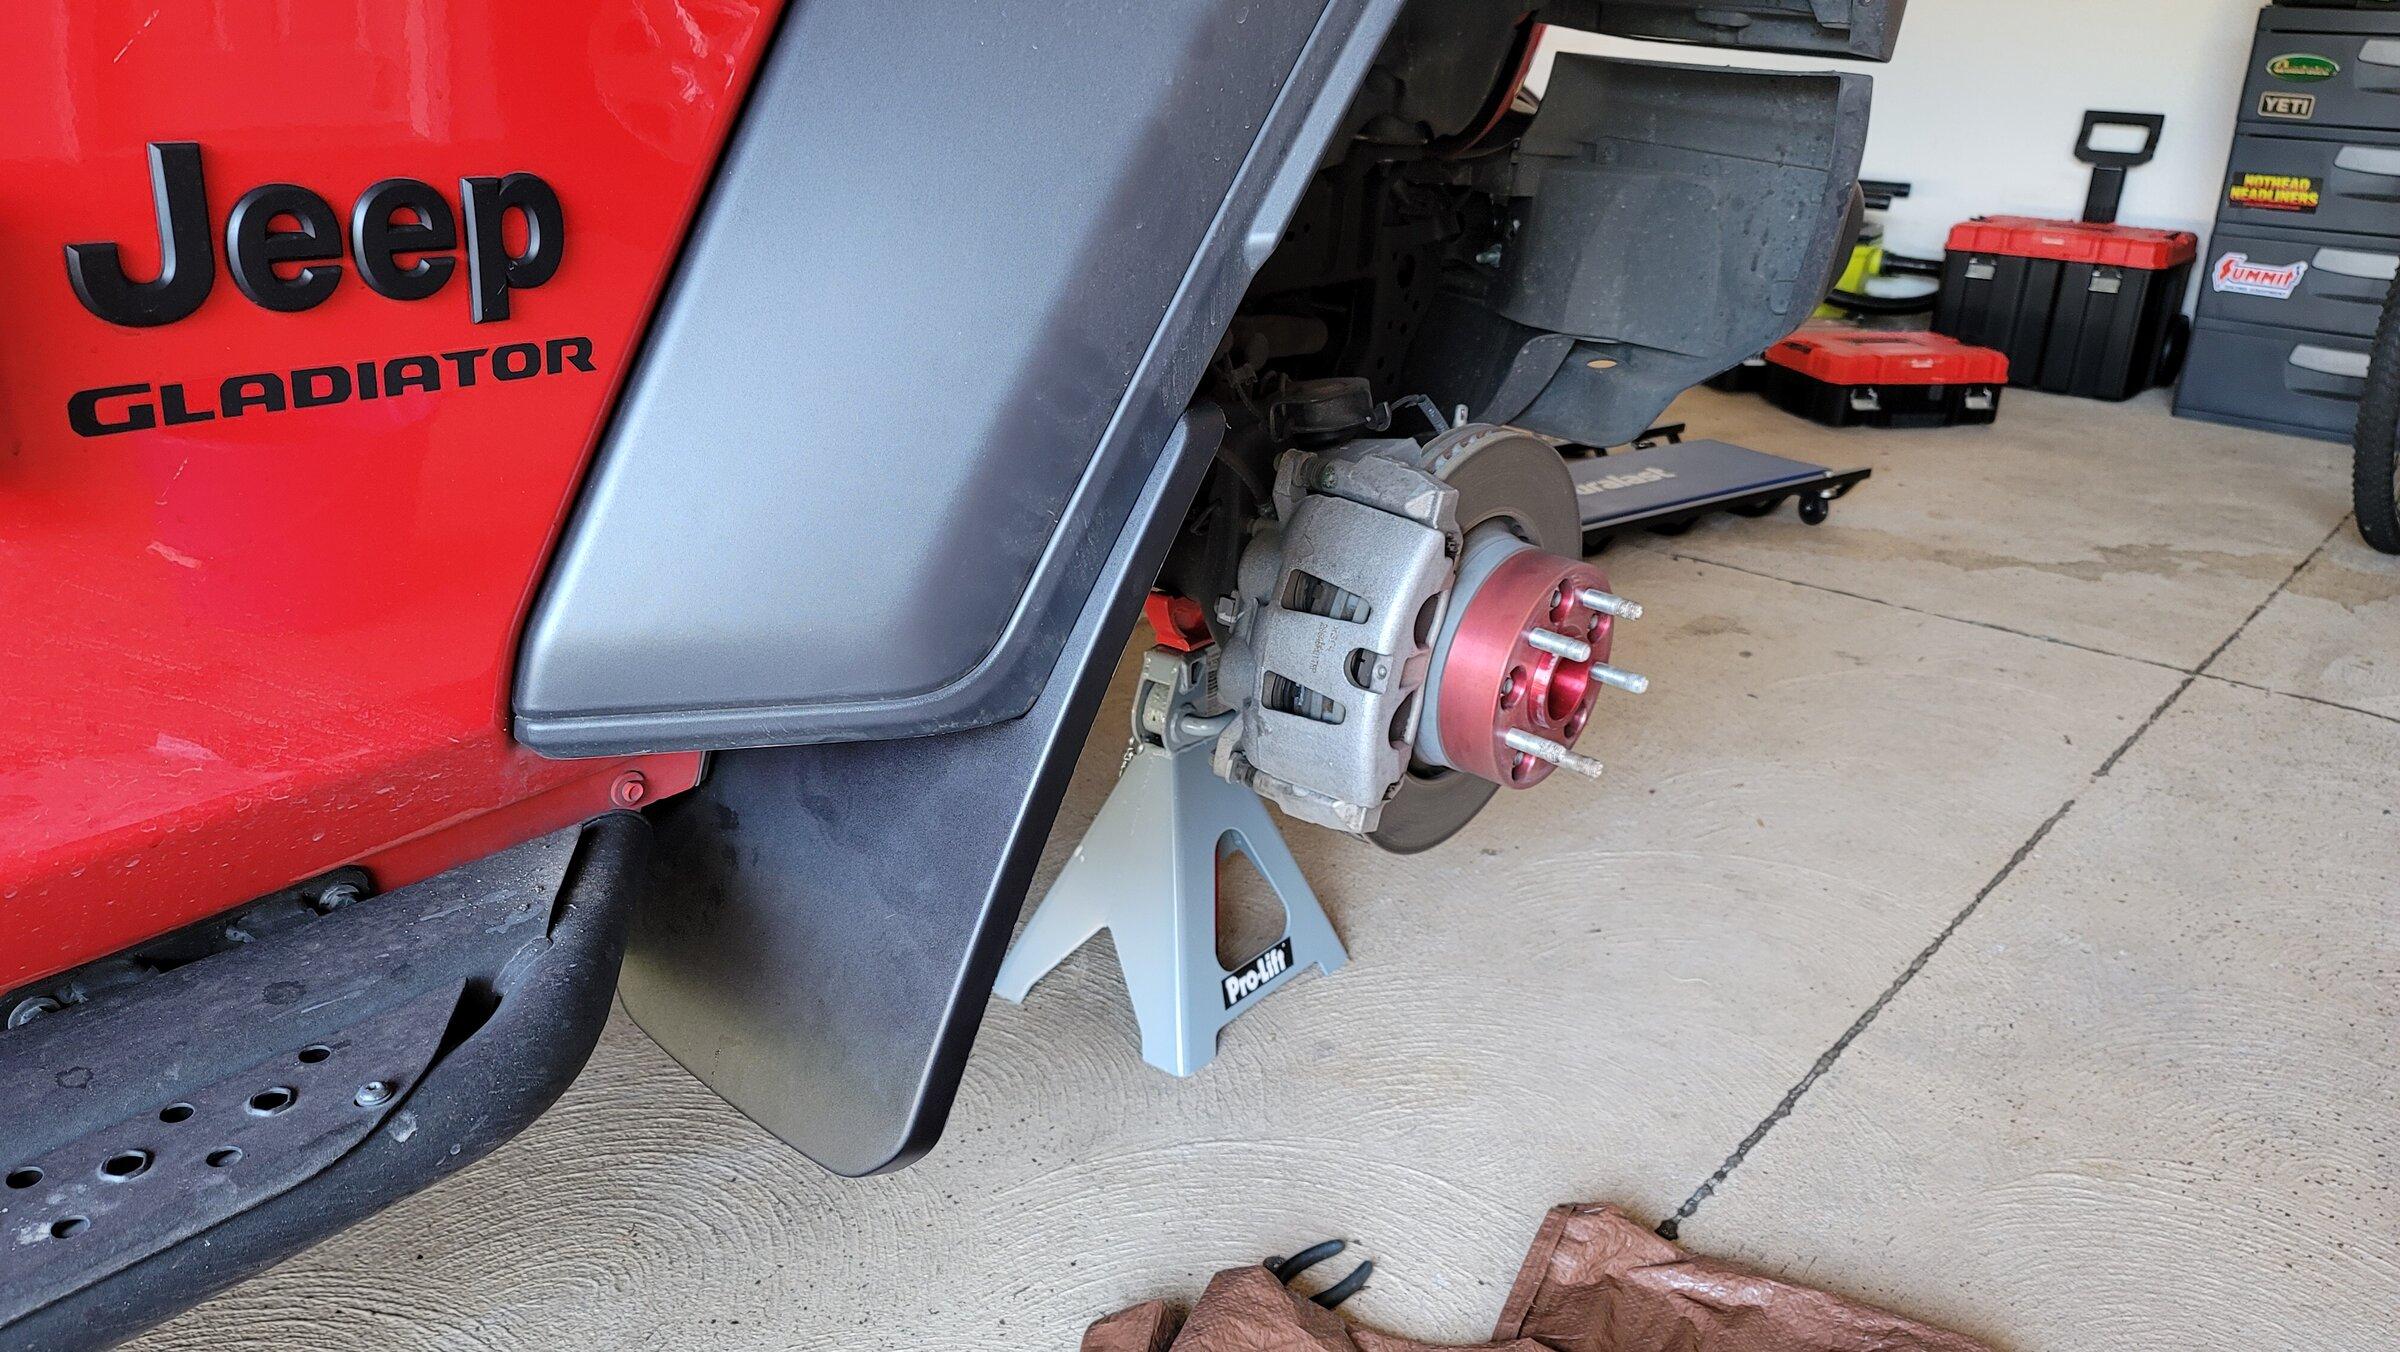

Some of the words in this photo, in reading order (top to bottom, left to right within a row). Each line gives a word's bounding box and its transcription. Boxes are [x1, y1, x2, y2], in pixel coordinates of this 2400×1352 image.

[2265, 96, 2309, 115] YETI
[2229, 185, 2319, 207] HEADLINERS
[65, 141, 565, 328] Jeep
[2218, 258, 2294, 286] SUMMIT
[67, 336, 597, 438] GLADIATOR
[1576, 467, 1676, 495] uralast
[1225, 948, 1287, 1005] Pro-Lift
